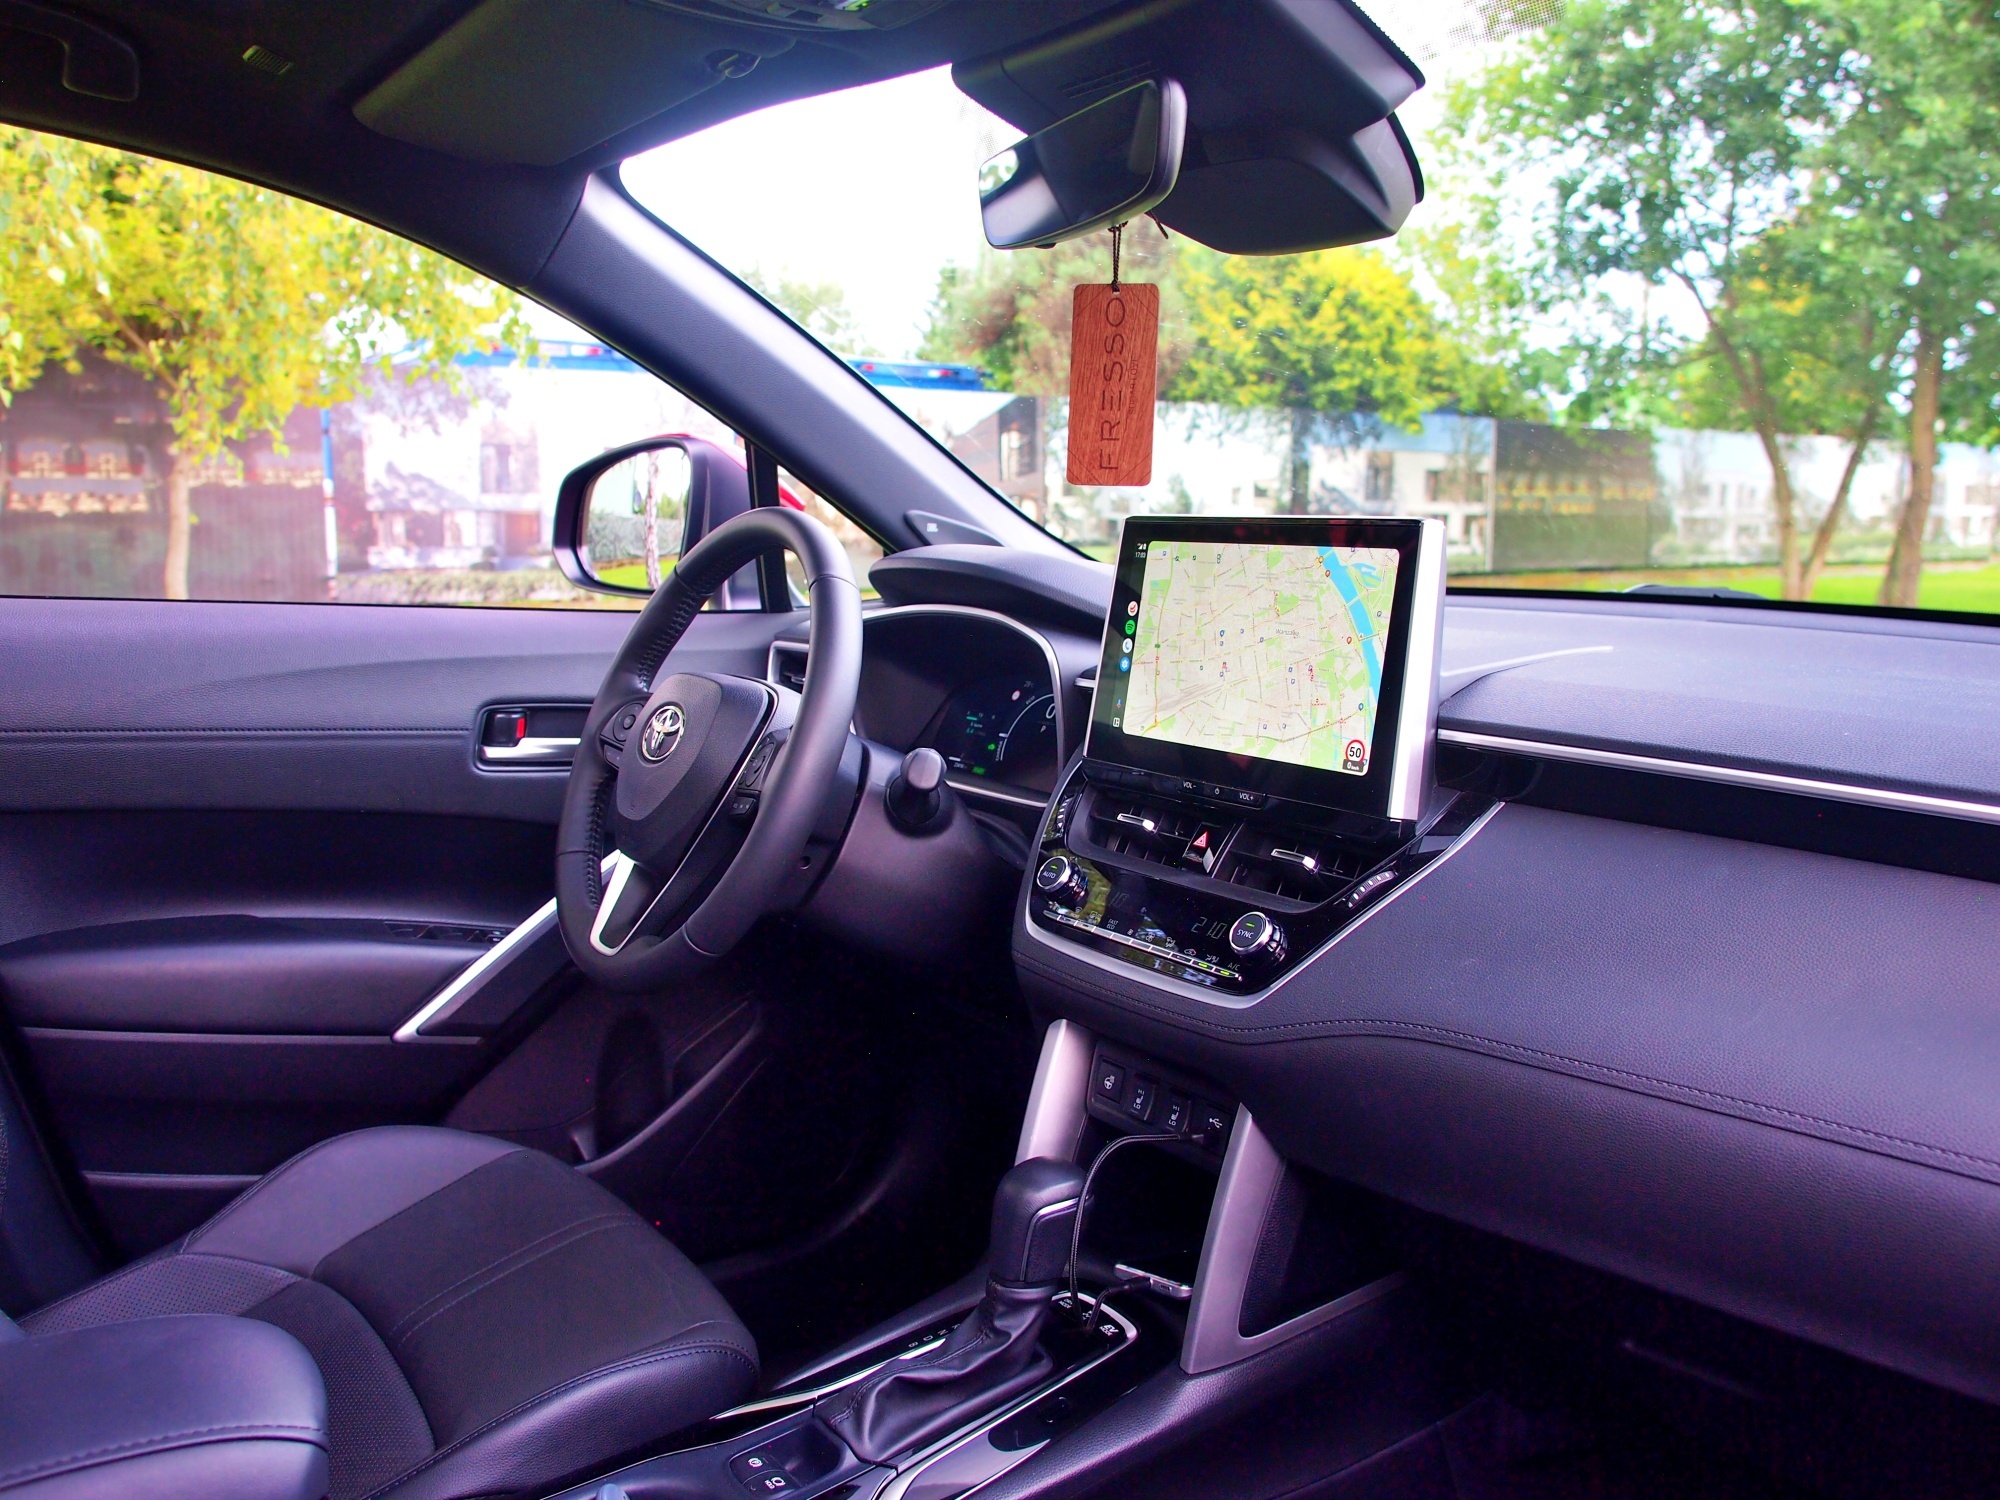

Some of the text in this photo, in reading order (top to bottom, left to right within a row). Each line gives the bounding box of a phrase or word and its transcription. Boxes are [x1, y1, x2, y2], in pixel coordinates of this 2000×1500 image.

[1100, 297, 1126, 470] FRESSO
[1349, 746, 1361, 758] 50
[1042, 870, 1056, 879] AUTO
[1107, 918, 1119, 926] FAST
[1236, 929, 1254, 939] SYNC
[1227, 962, 1241, 971] A/C
